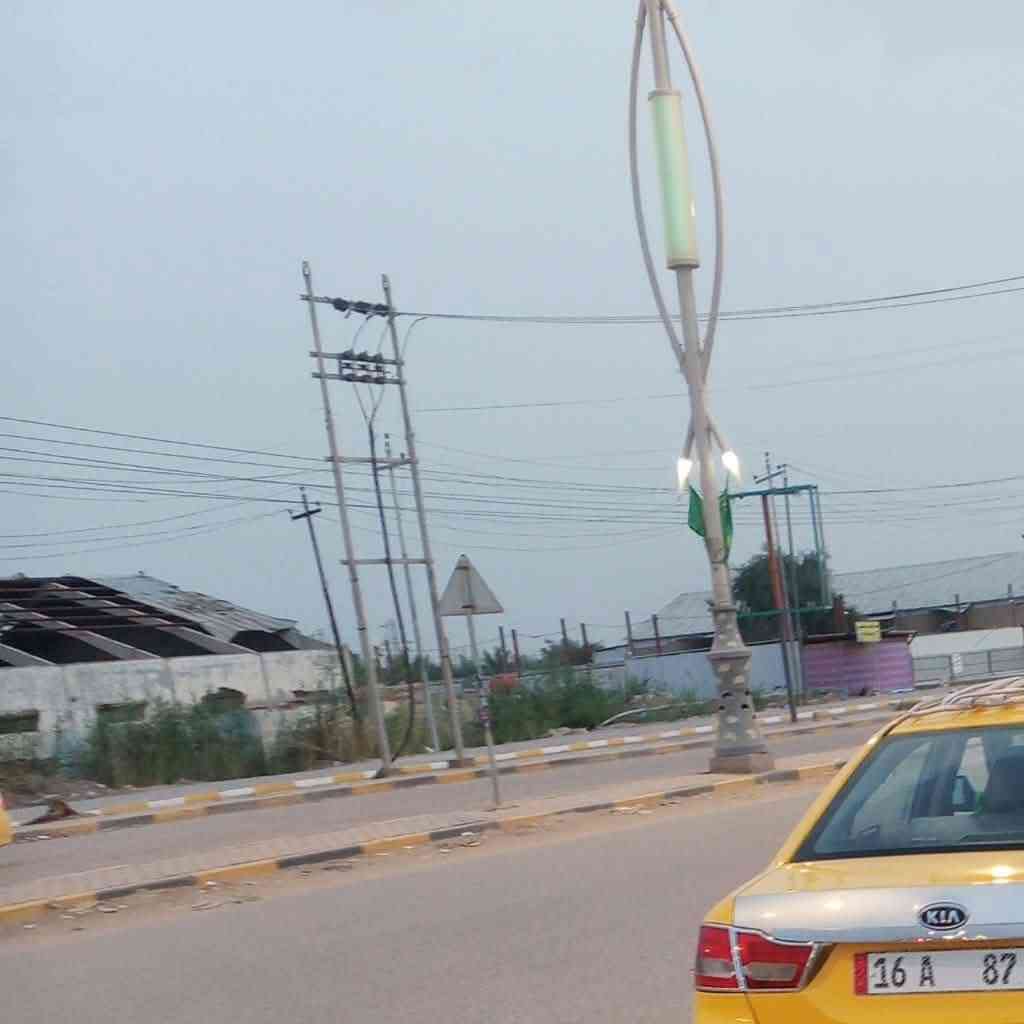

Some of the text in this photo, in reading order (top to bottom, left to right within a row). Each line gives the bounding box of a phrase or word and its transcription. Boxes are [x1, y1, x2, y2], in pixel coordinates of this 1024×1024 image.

[926, 909, 960, 925] KIA
[873, 951, 1018, 989] 16 A 87
